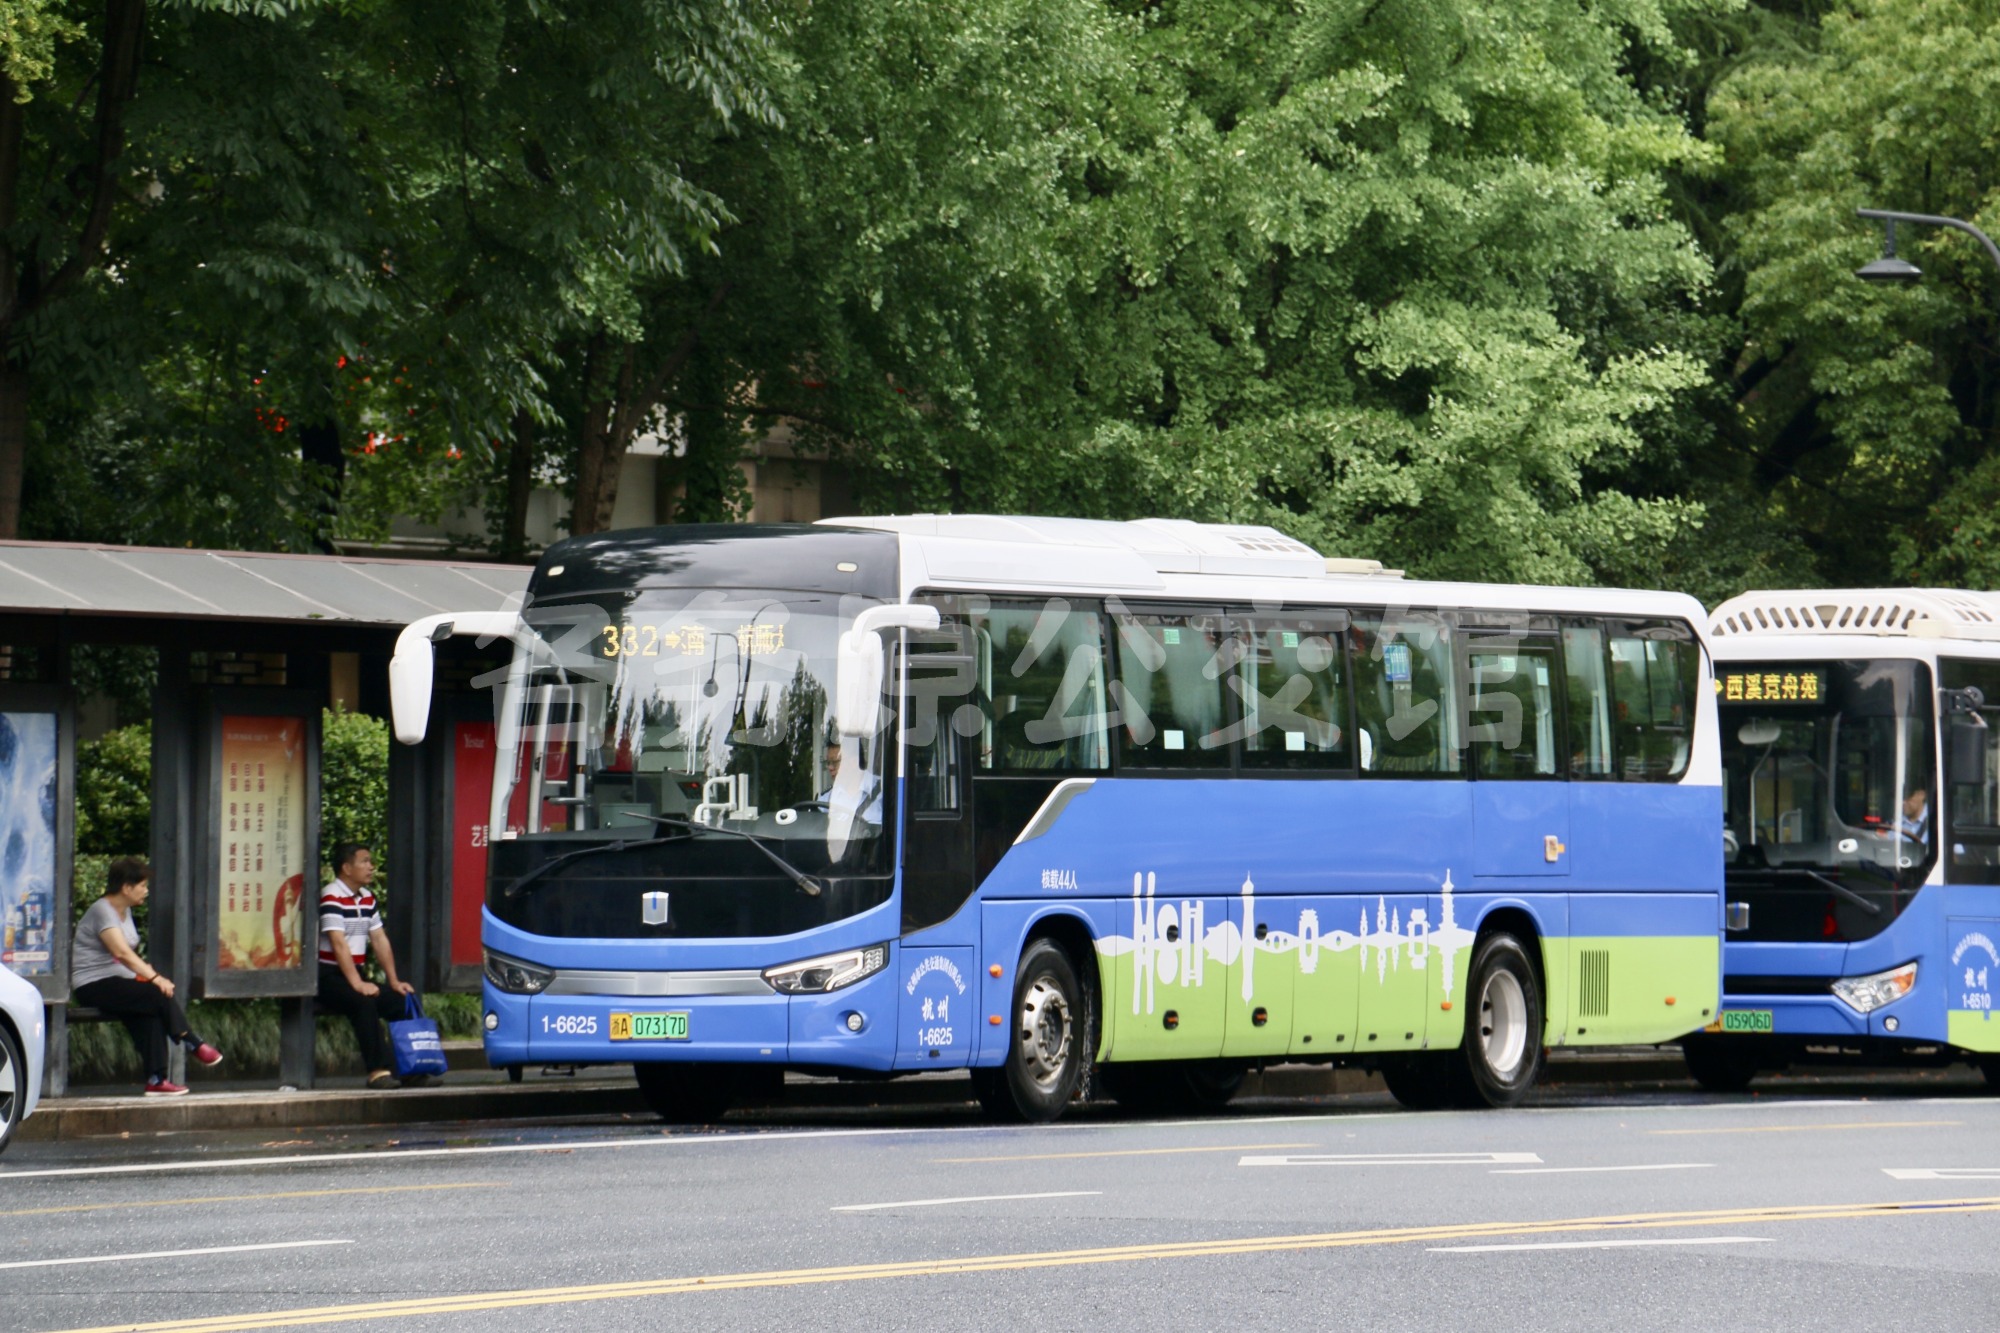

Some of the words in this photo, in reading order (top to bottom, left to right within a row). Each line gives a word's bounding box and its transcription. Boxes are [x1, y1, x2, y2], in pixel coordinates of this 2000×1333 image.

[603, 625, 658, 656] 332
[1041, 869, 1078, 889] 核载44人
[921, 995, 949, 1023] 杭州
[541, 1015, 598, 1035] 1-6625
[918, 1027, 953, 1047] 1-6625
